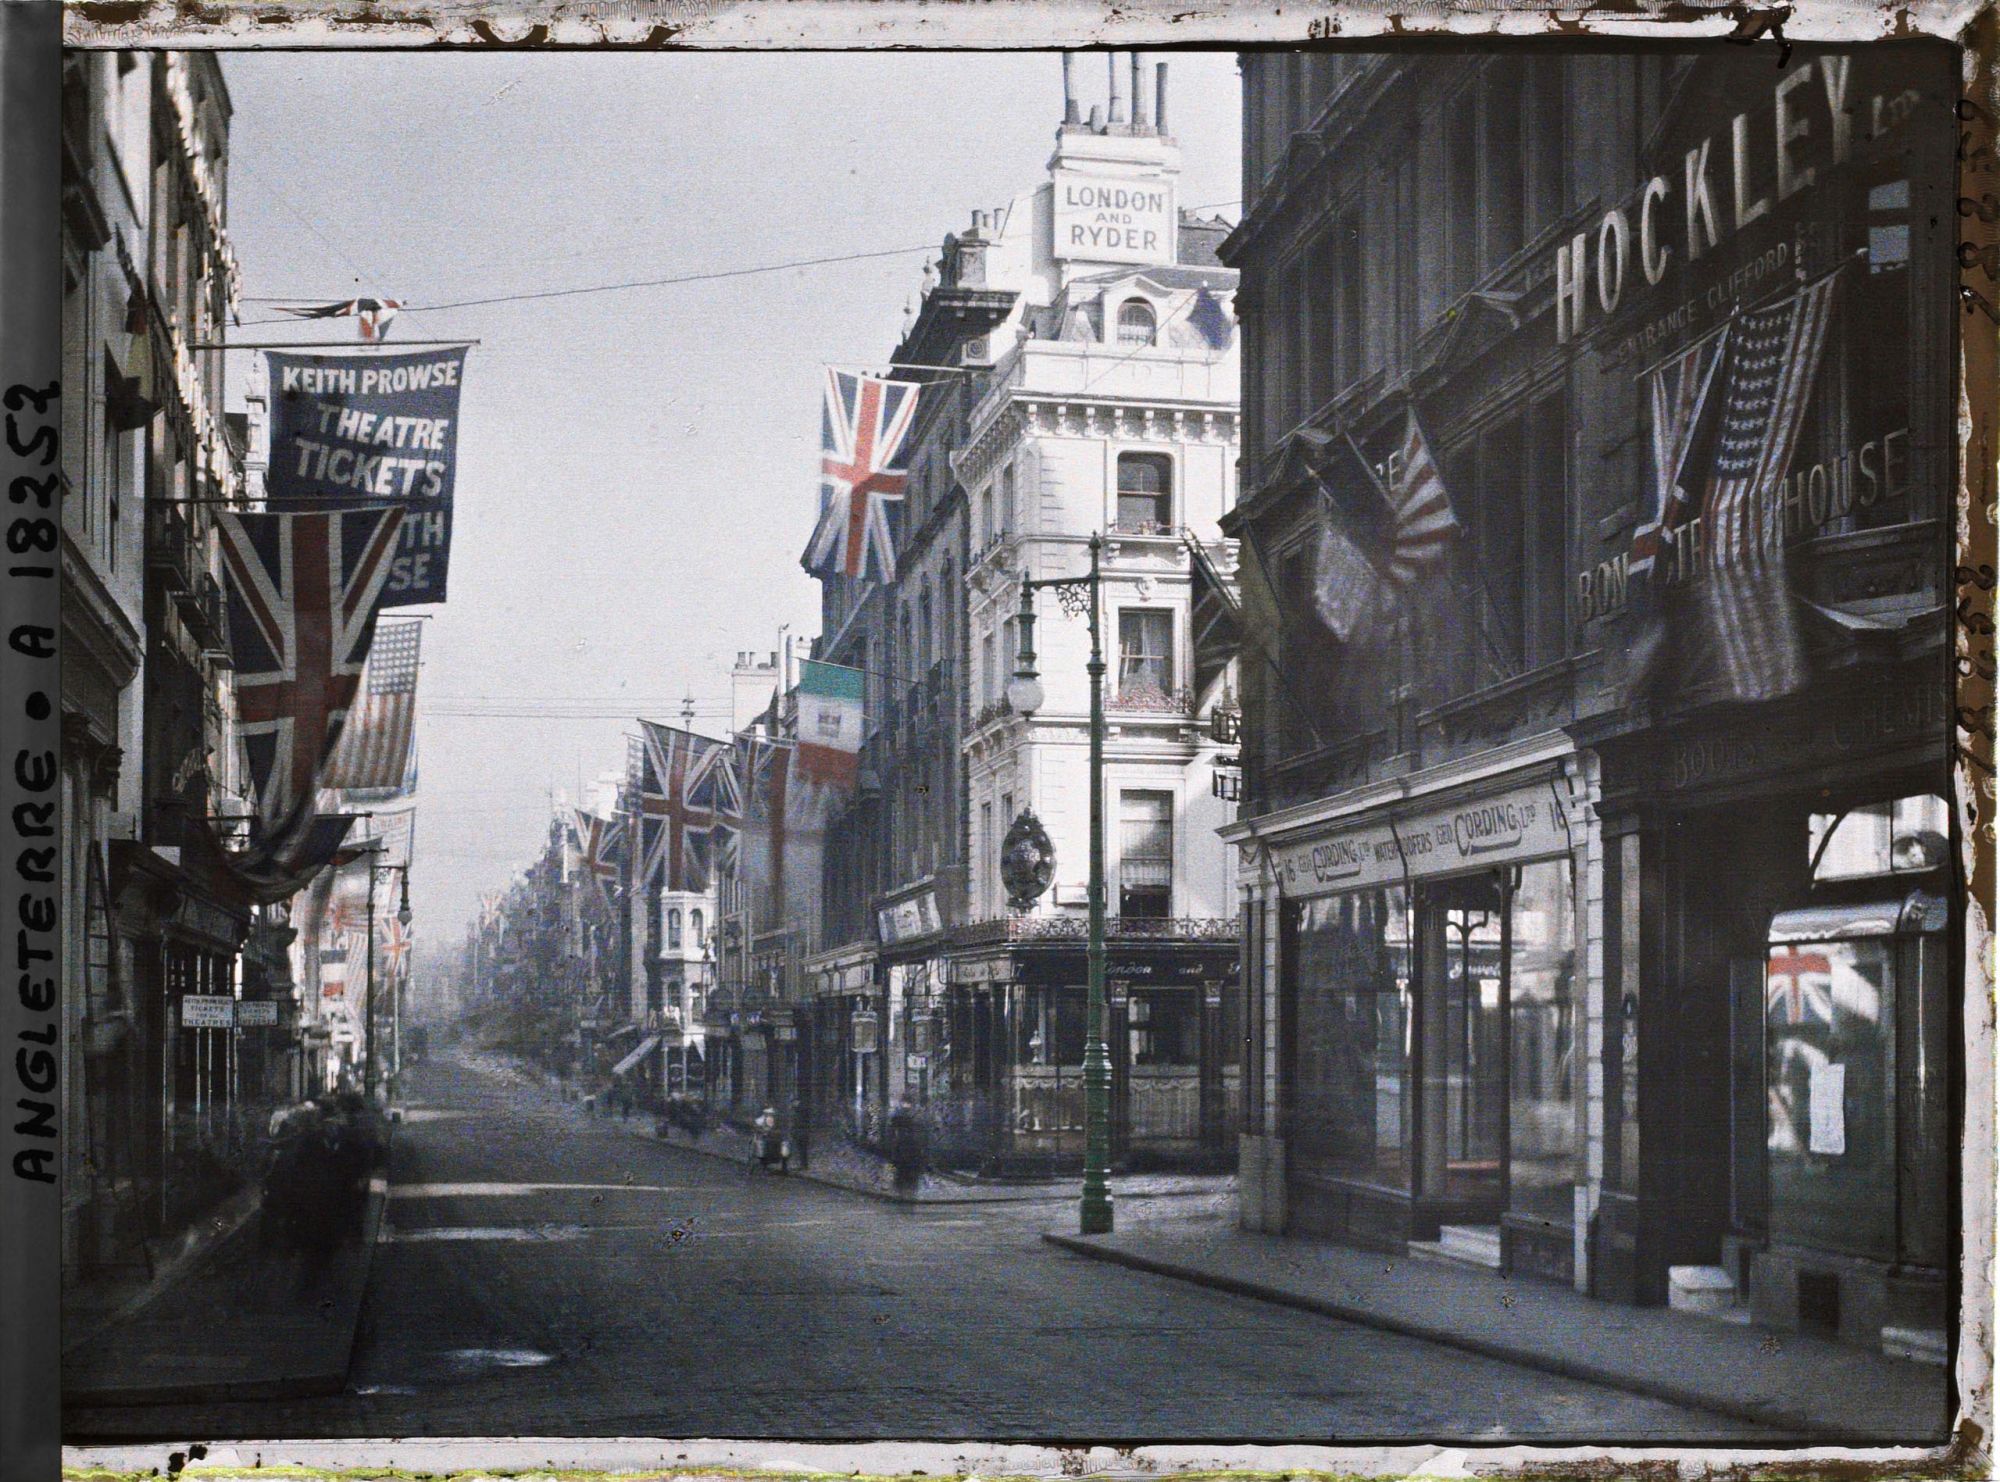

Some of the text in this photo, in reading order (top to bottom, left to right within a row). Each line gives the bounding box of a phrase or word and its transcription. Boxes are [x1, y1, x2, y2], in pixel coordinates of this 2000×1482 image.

[1066, 185, 1163, 213] LONDON
[1095, 212, 1132, 224] AND
[1557, 55, 1850, 345] HOCKLEY
[1071, 224, 1157, 250] RYDER
[1707, 242, 1788, 310] CLIFFORD
[282, 360, 460, 394] KEITH PROWSE
[317, 402, 449, 449] THEATRE
[295, 437, 446, 497] TICKETS
[1578, 550, 1630, 622] BON
[1783, 429, 1909, 539] HOUSE
[1312, 840, 1360, 883] CORDING
[1455, 803, 1519, 857] CORDING
[183, 1018, 231, 1026] THEATRES
